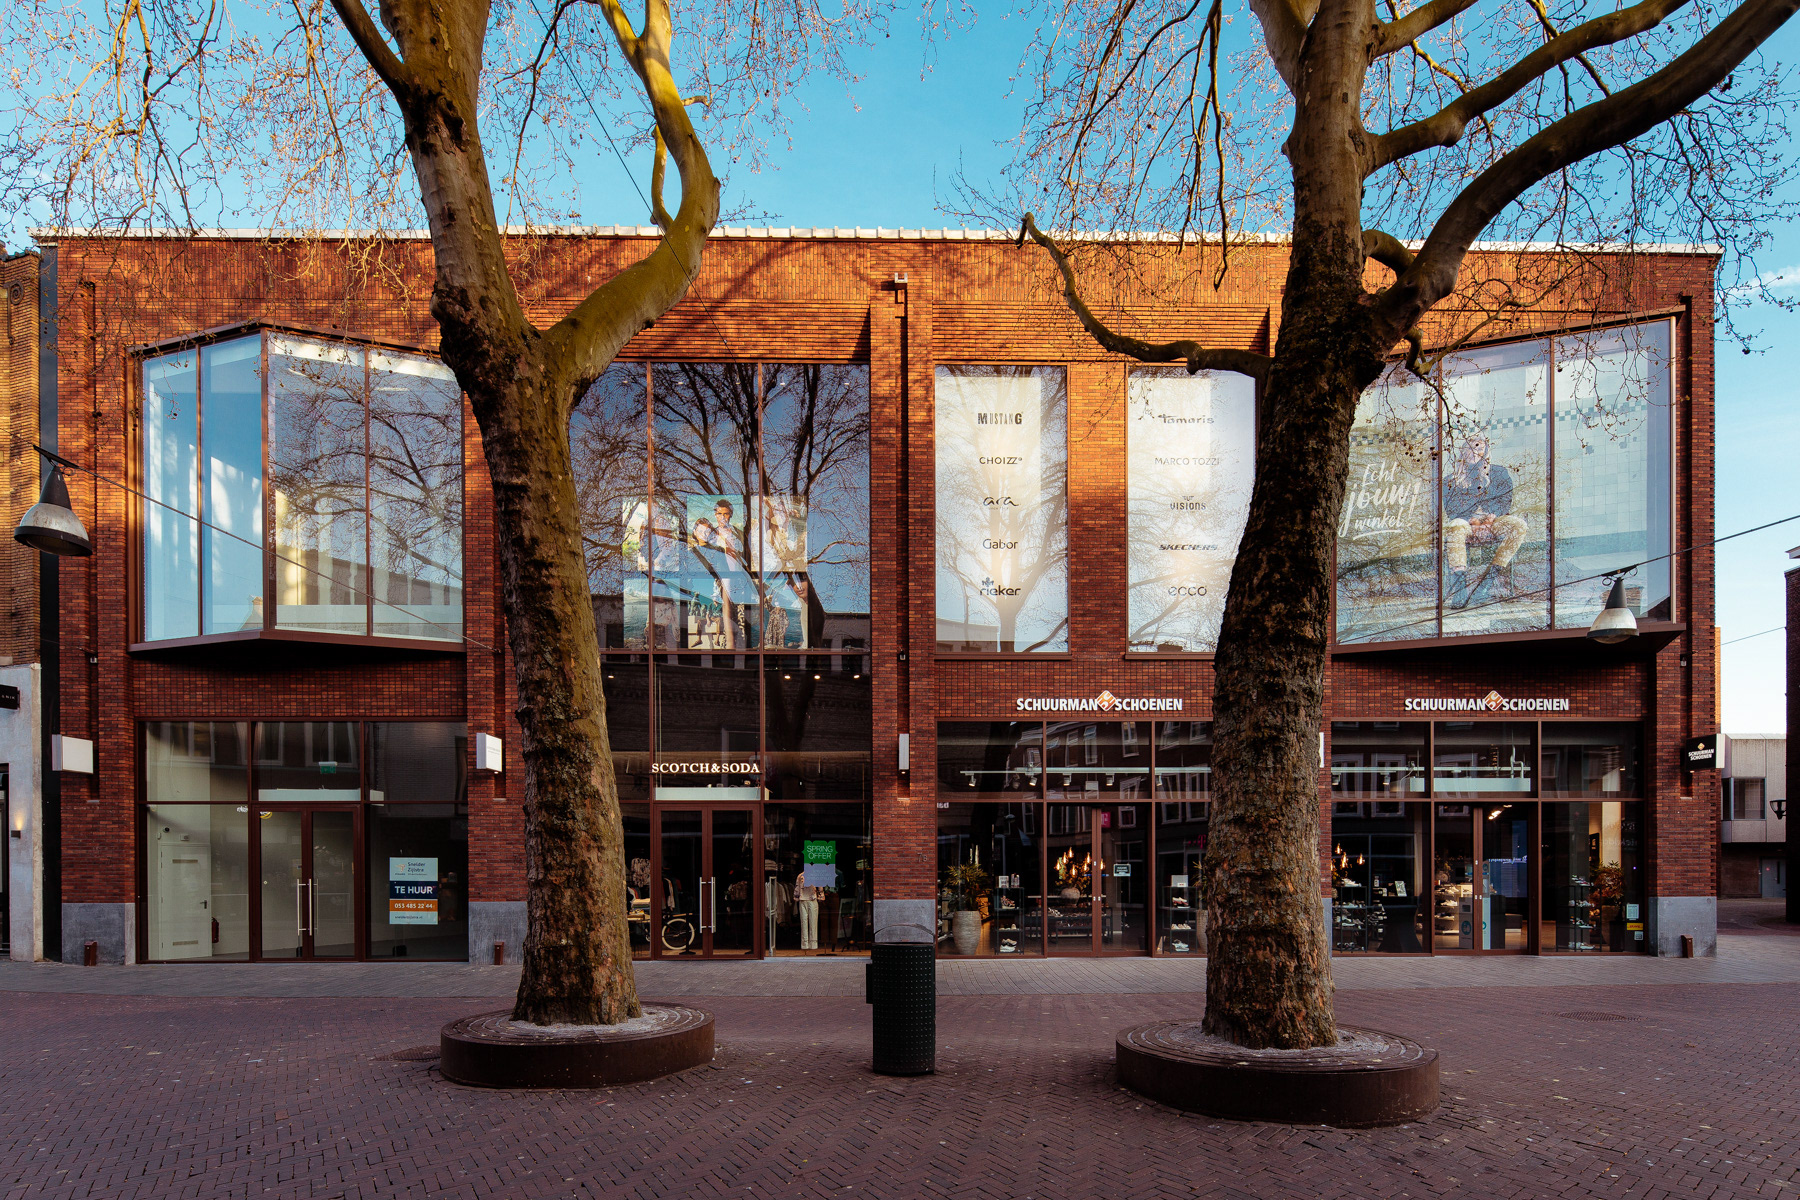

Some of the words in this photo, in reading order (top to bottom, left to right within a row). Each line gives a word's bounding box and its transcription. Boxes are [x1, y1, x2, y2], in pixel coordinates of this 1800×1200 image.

[977, 412, 1022, 425] MUSTANG
[1158, 414, 1215, 424] Tamaris
[1154, 457, 1190, 466] MARCO
[1192, 457, 1220, 466] TOZZI
[1361, 461, 1397, 487] Echt
[983, 496, 1020, 507] ara
[982, 538, 1019, 550] Gabor
[979, 584, 1021, 596] rieker
[1168, 586, 1207, 597] ecco
[1016, 698, 1098, 711] SCHUURMAN
[1114, 698, 1183, 711] SCHOENEN
[1404, 698, 1486, 711] SCHUURMAN
[1502, 698, 1570, 711] SCHOENEN
[651, 763, 760, 774] SCOTCH&SODA
[806, 845, 834, 853] SPRING
[808, 852, 832, 860] OFFER
[394, 885, 406, 894] TE
[407, 885, 433, 894] HUUR
